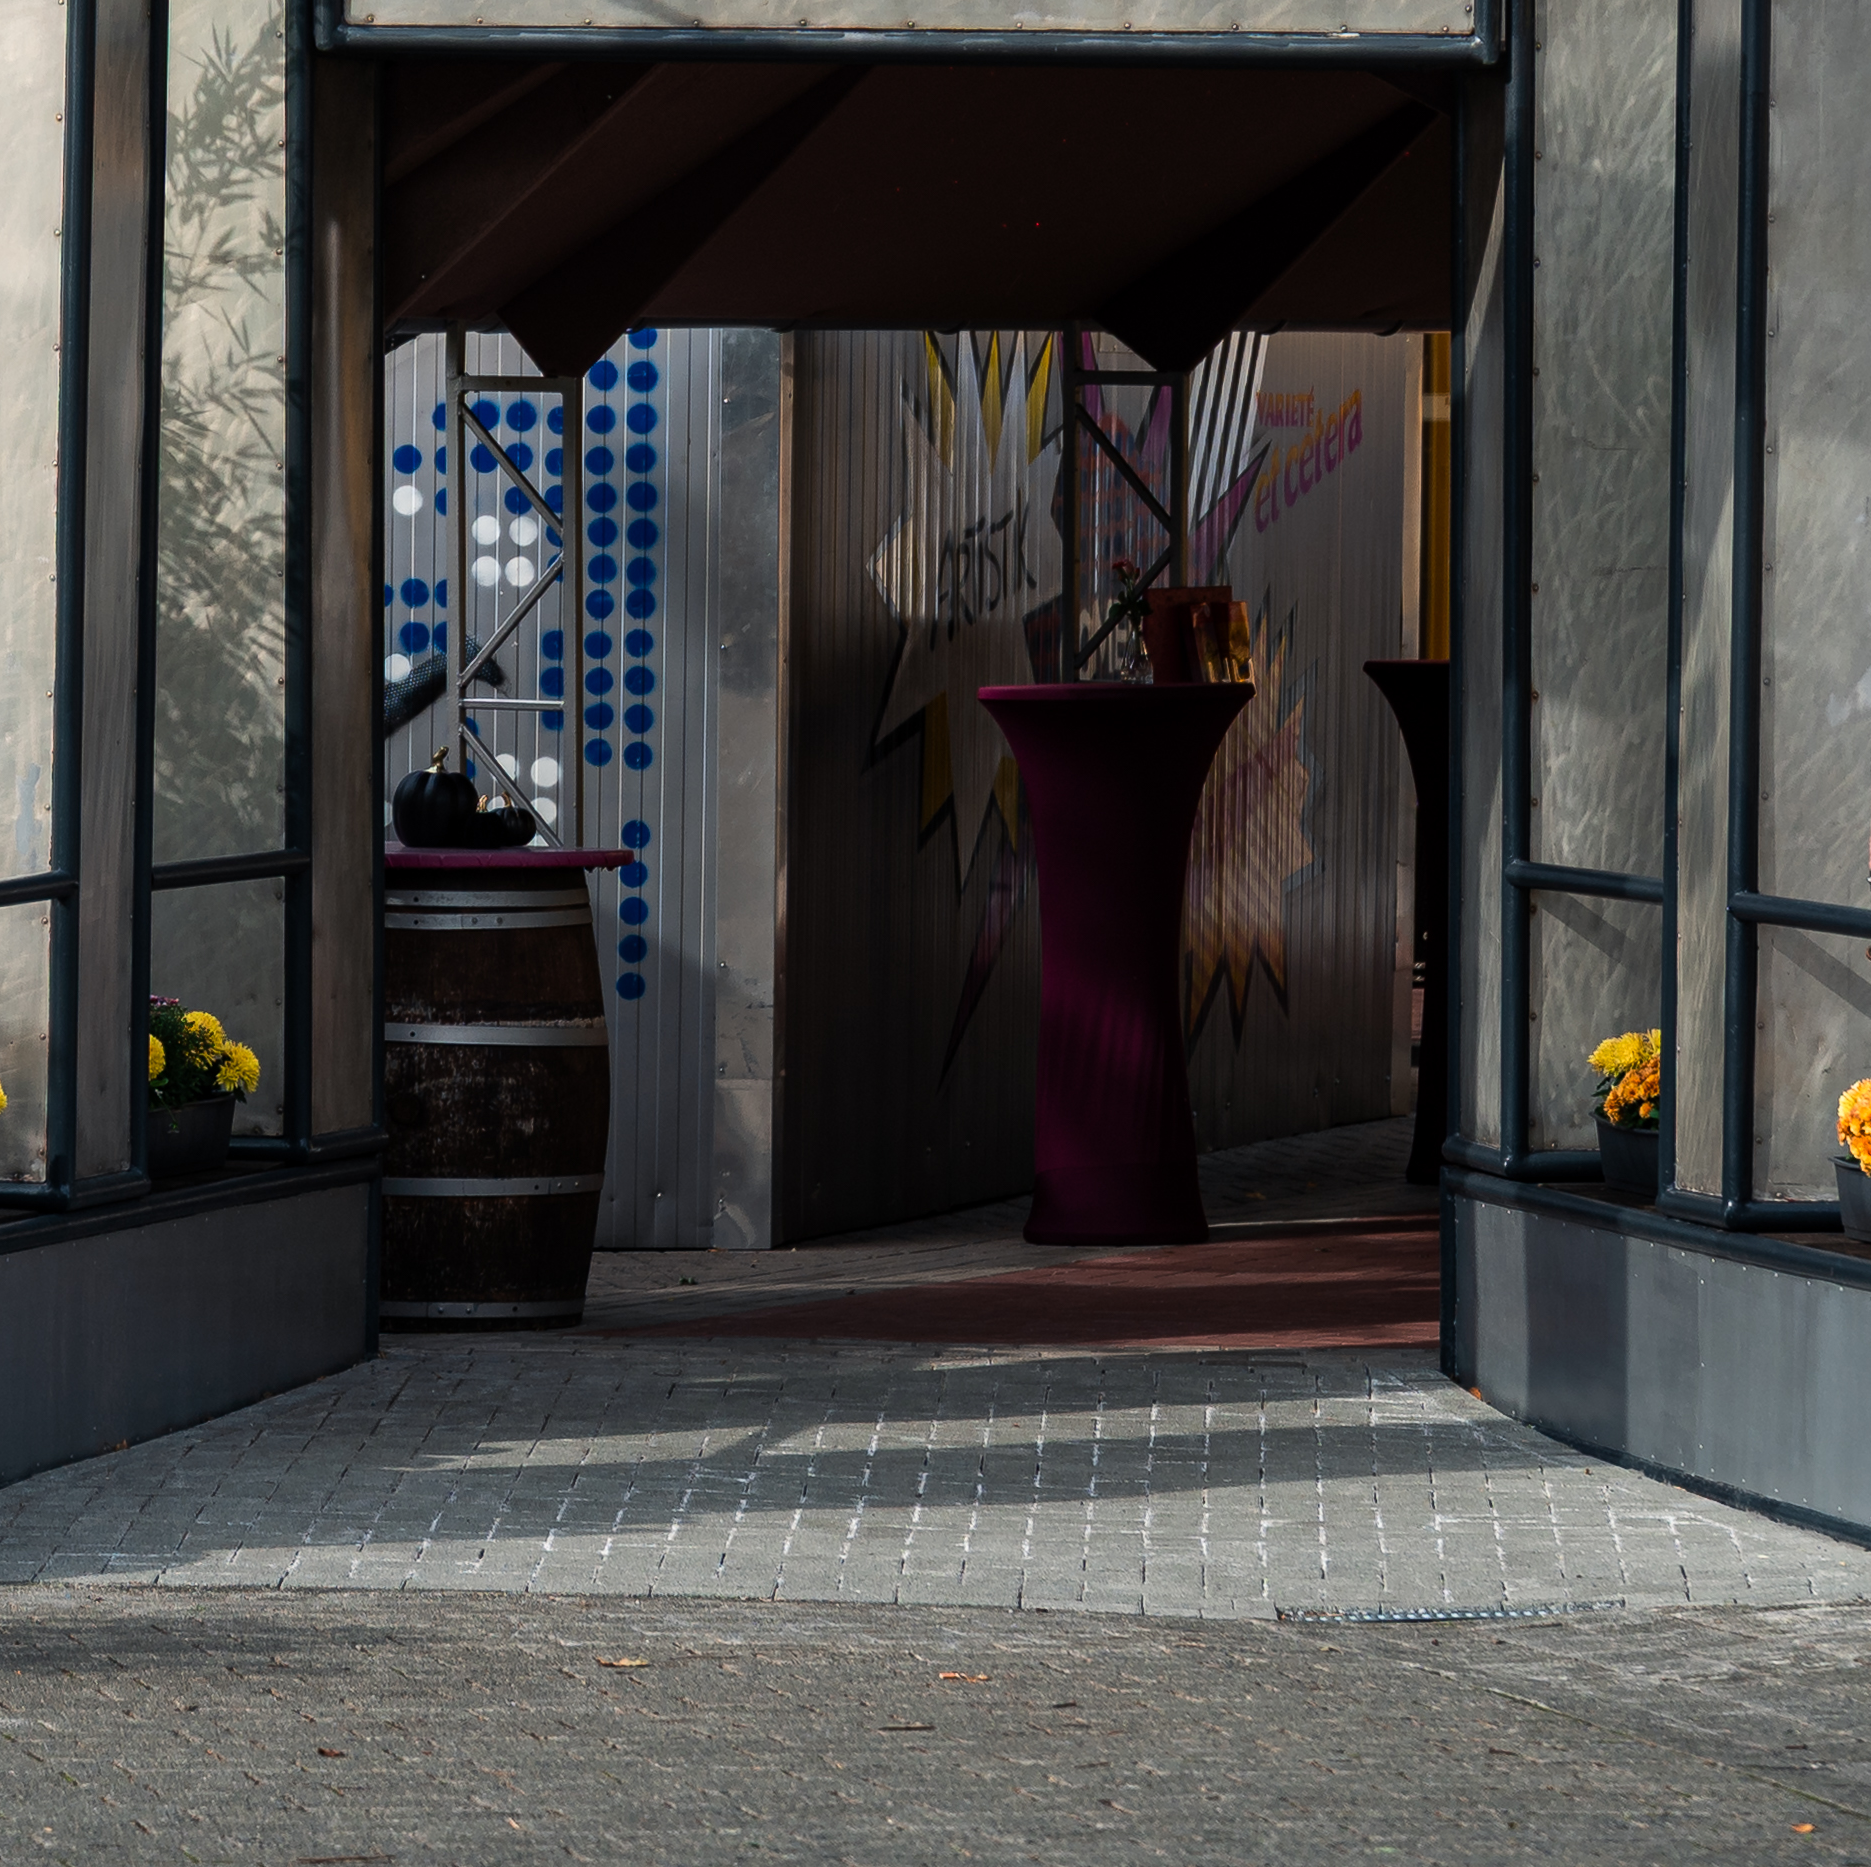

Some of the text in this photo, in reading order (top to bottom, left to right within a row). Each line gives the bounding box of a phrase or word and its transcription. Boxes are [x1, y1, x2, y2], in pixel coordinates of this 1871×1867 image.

[1256, 386, 1314, 427] VARIETÉ
[1255, 389, 1363, 533] et cetera
